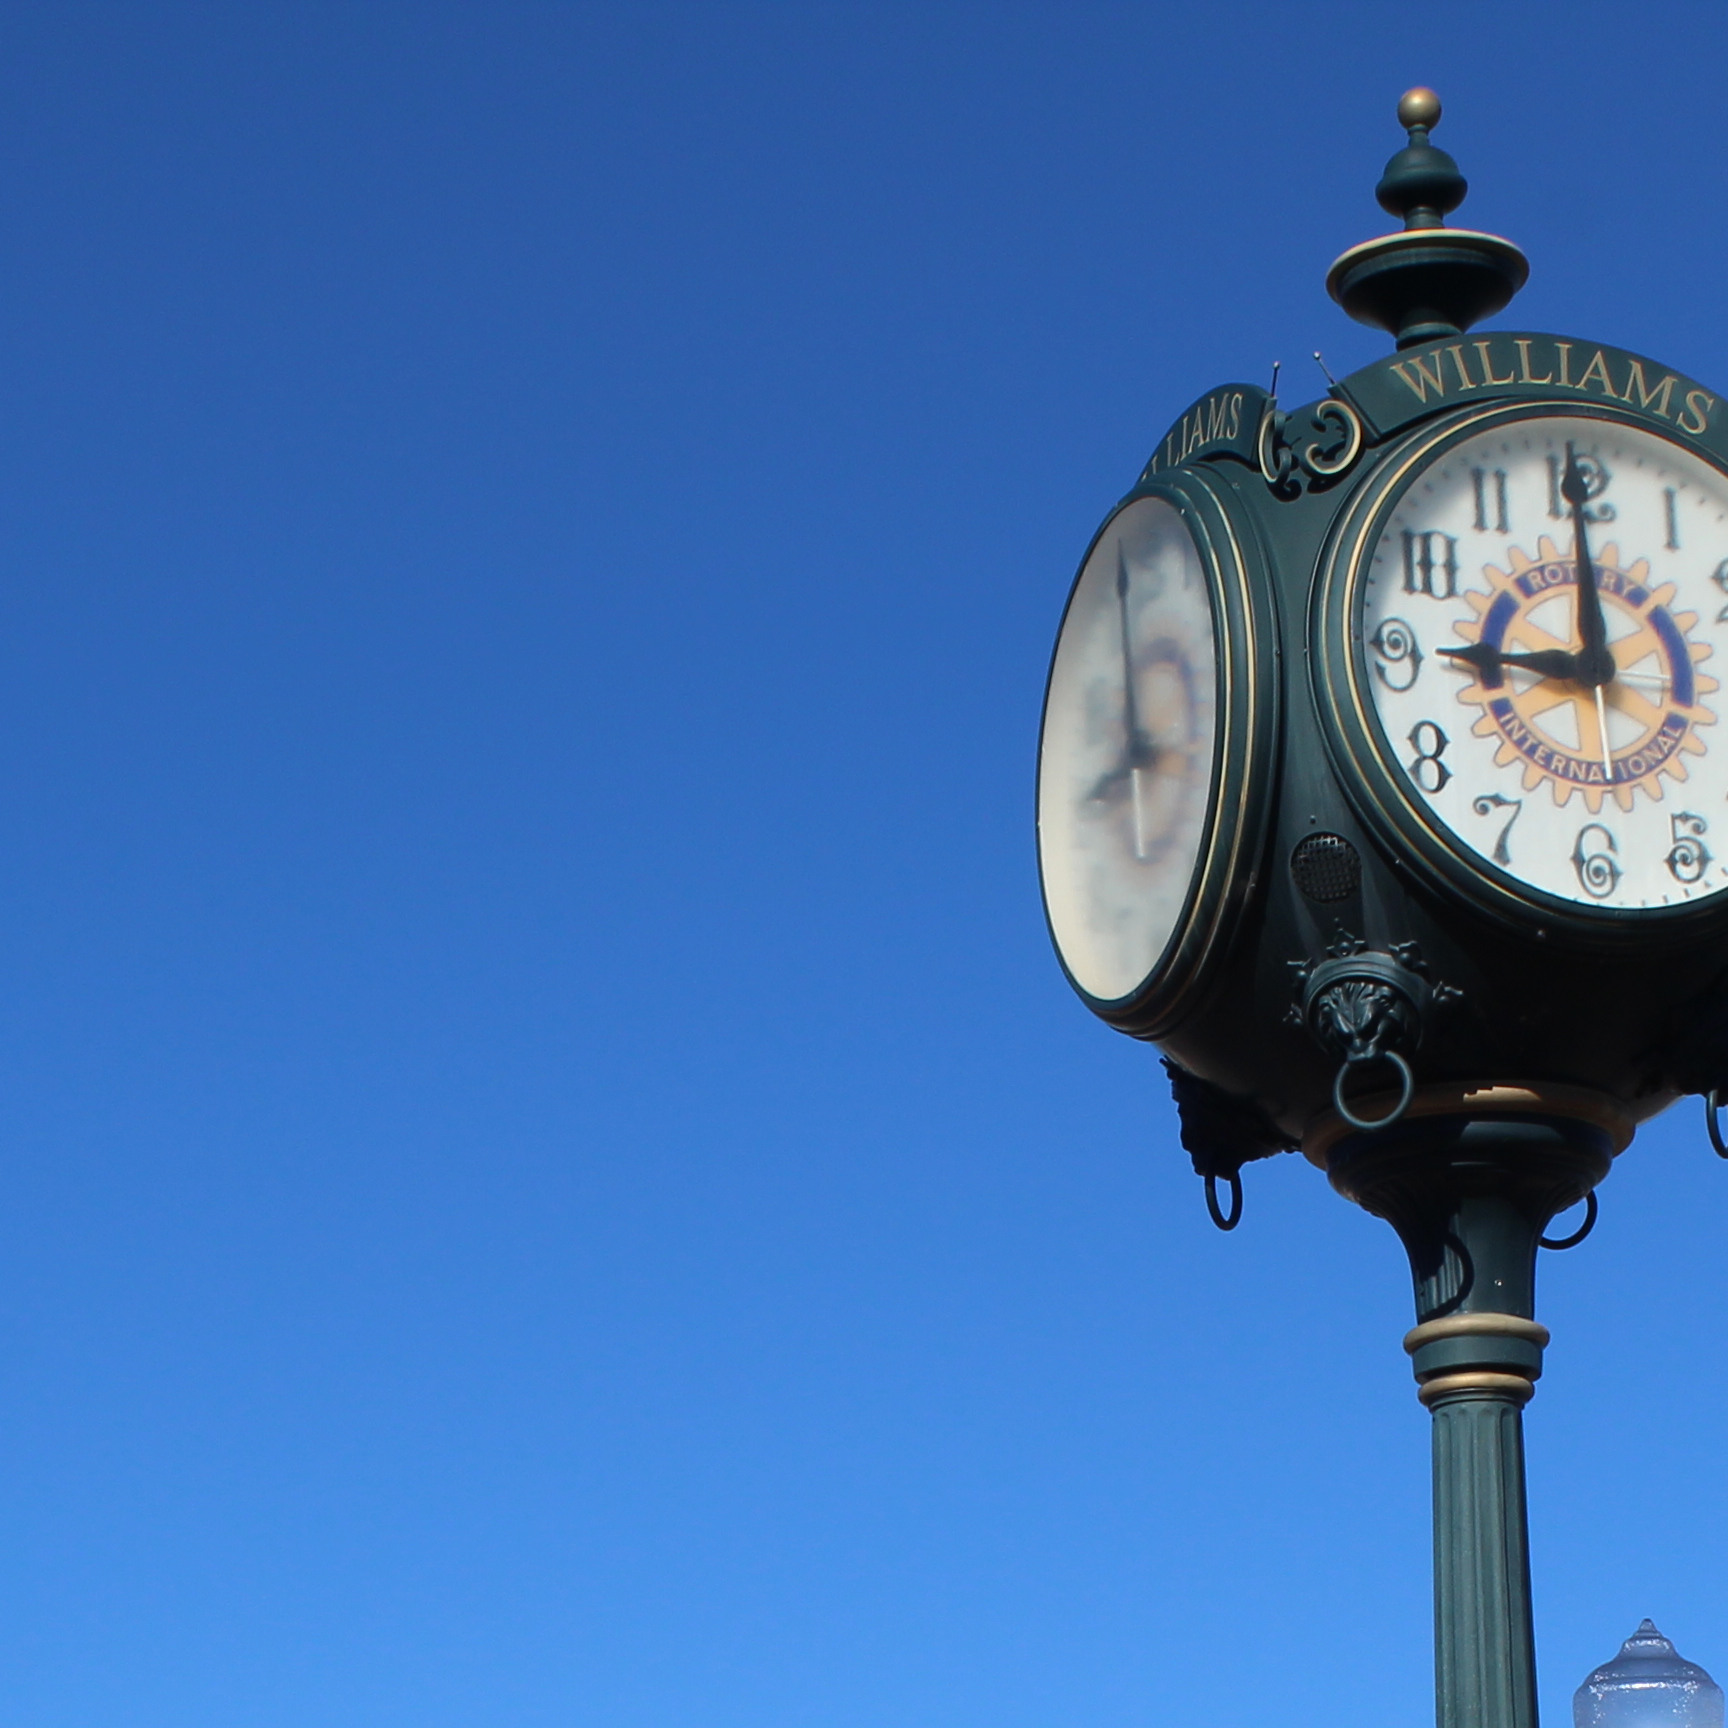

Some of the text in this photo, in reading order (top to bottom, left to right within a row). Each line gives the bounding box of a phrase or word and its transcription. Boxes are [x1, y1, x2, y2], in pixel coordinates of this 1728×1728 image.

[1389, 338, 1715, 435] WILLIAMS
[1472, 467, 1510, 534] 11
[1547, 454, 1617, 524] 12
[1662, 486, 1681, 551] 1
[1400, 527, 1460, 601] 10
[1527, 563, 1638, 596] ROTRY
[1369, 616, 1425, 693] 9
[1406, 718, 1454, 794] 8
[1499, 713, 1683, 783] INTERNAIONAL
[1472, 792, 1523, 868] 7
[1570, 823, 1625, 899] 6
[1663, 811, 1714, 885] 5
